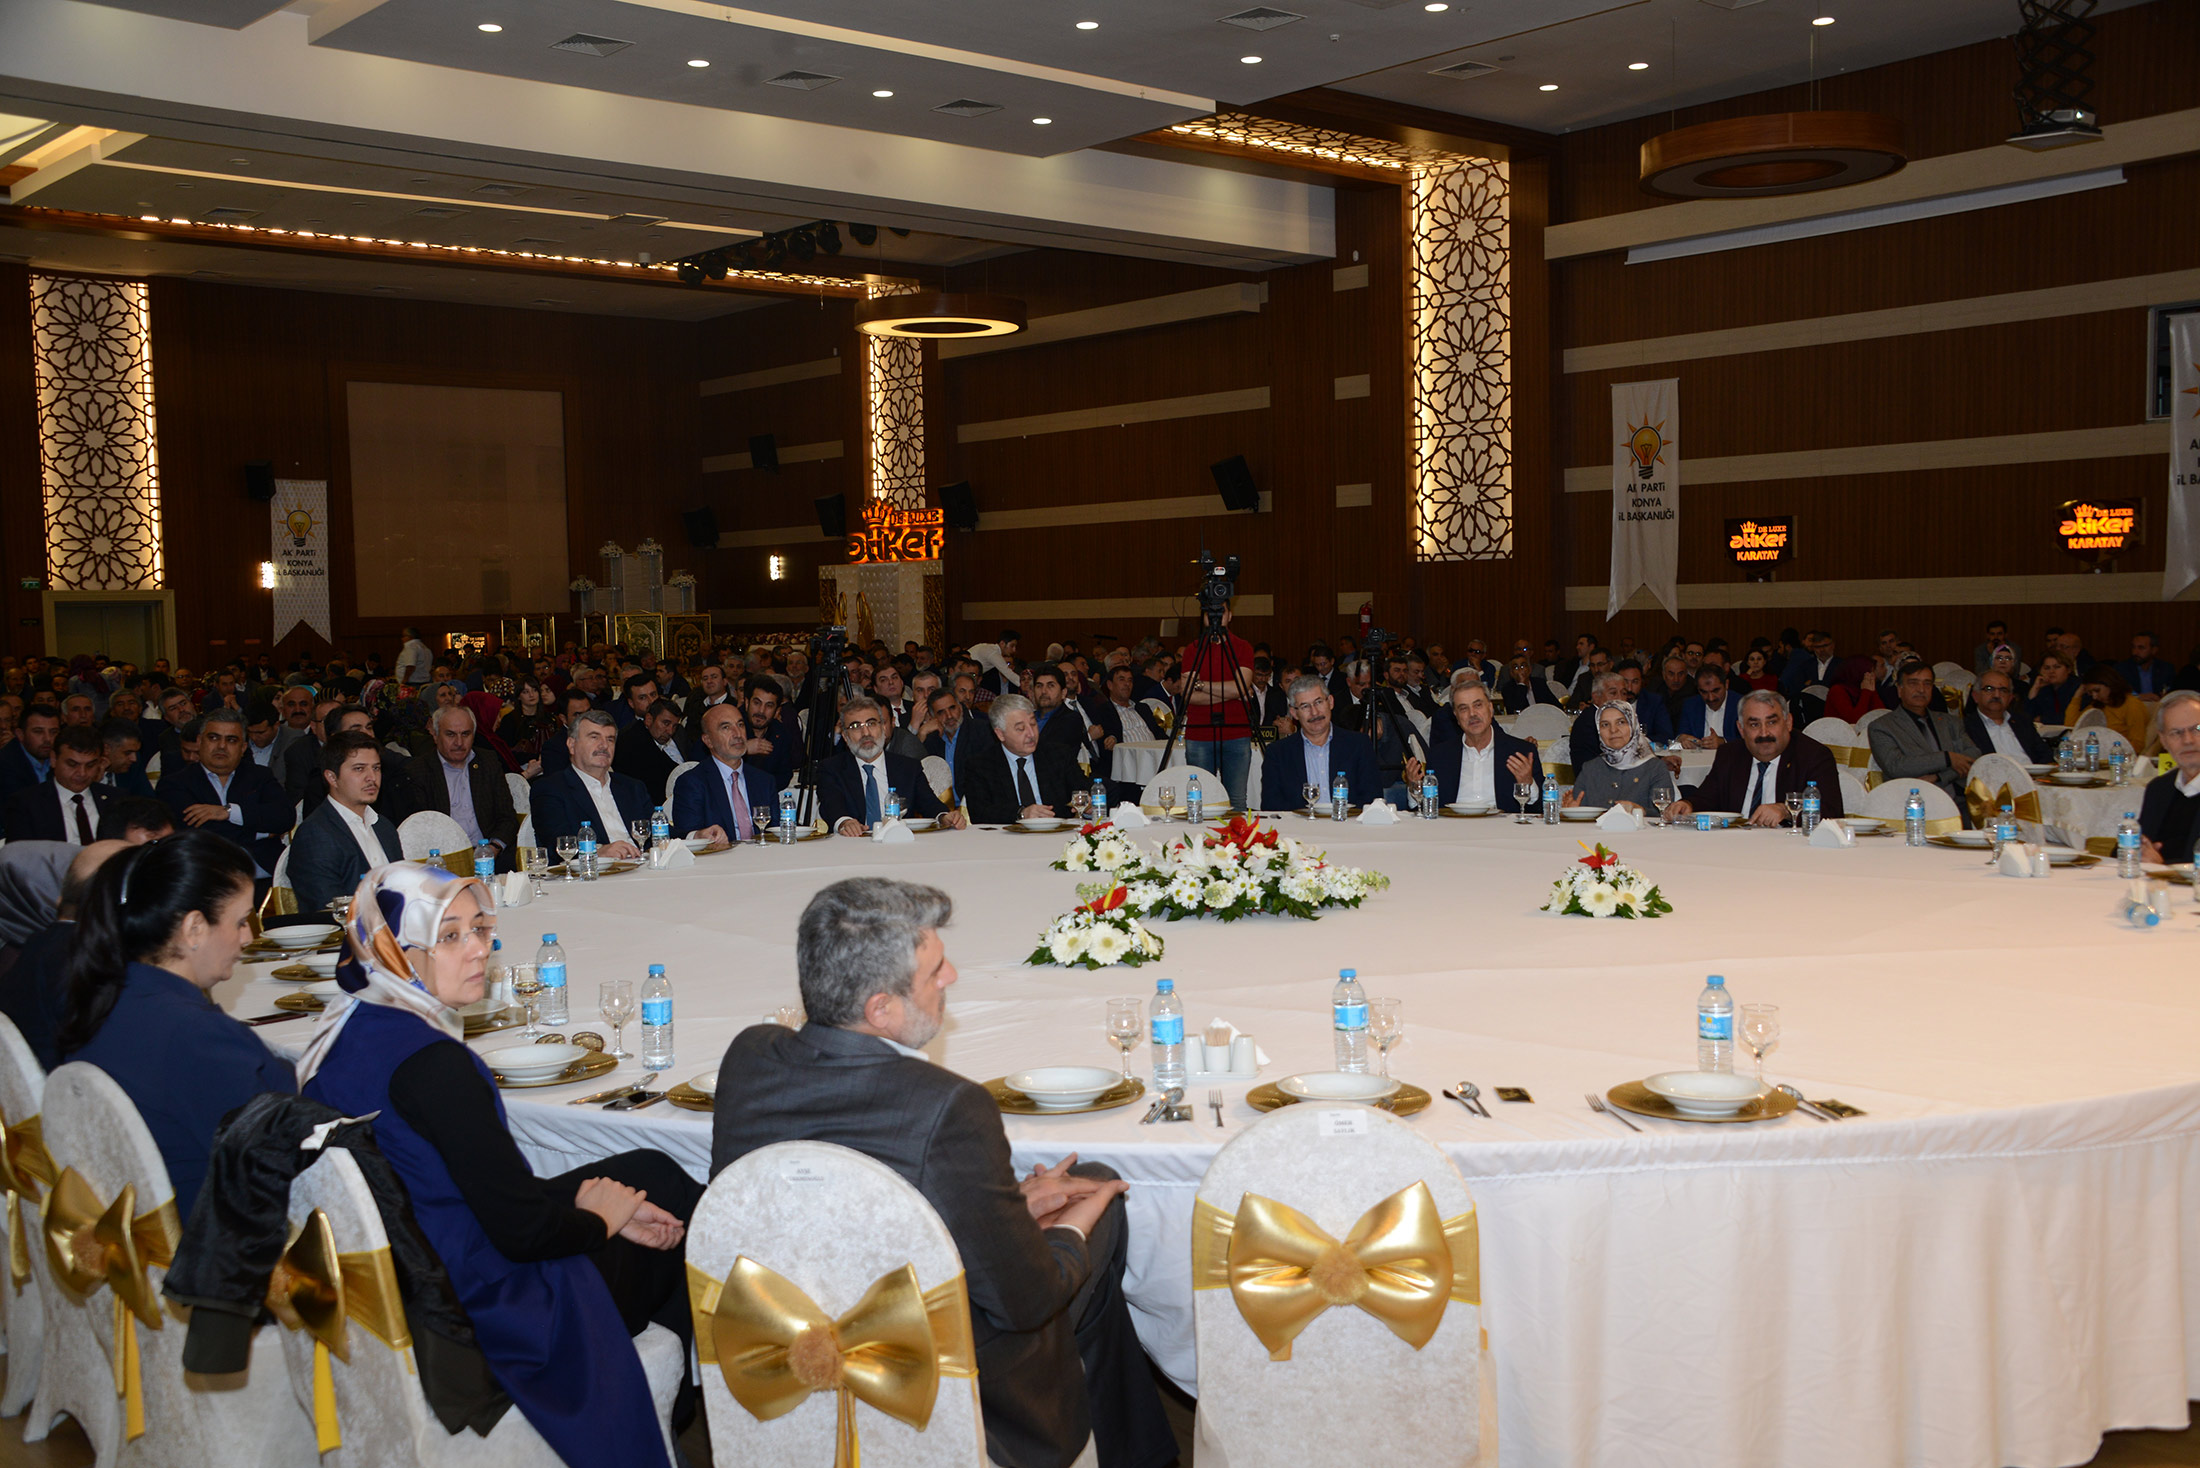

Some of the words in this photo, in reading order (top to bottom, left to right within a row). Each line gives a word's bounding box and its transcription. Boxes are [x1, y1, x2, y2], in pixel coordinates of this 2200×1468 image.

[2189, 438, 2200, 450] A
[1626, 483, 1637, 493] AK
[1641, 482, 1665, 492] PARTİ
[1631, 497, 1662, 508] KONYA
[907, 510, 939, 524] LUXE
[1627, 508, 1675, 522] BAŞKANLIĞI
[2109, 508, 2134, 517] LUXE
[1757, 525, 1768, 533] DE
[1768, 525, 1787, 533] LUXE
[1729, 532, 1787, 549] atiker
[2068, 536, 2124, 549] KARATAY
[1736, 550, 1780, 561] KARATAY
[287, 559, 314, 567] KONYA
